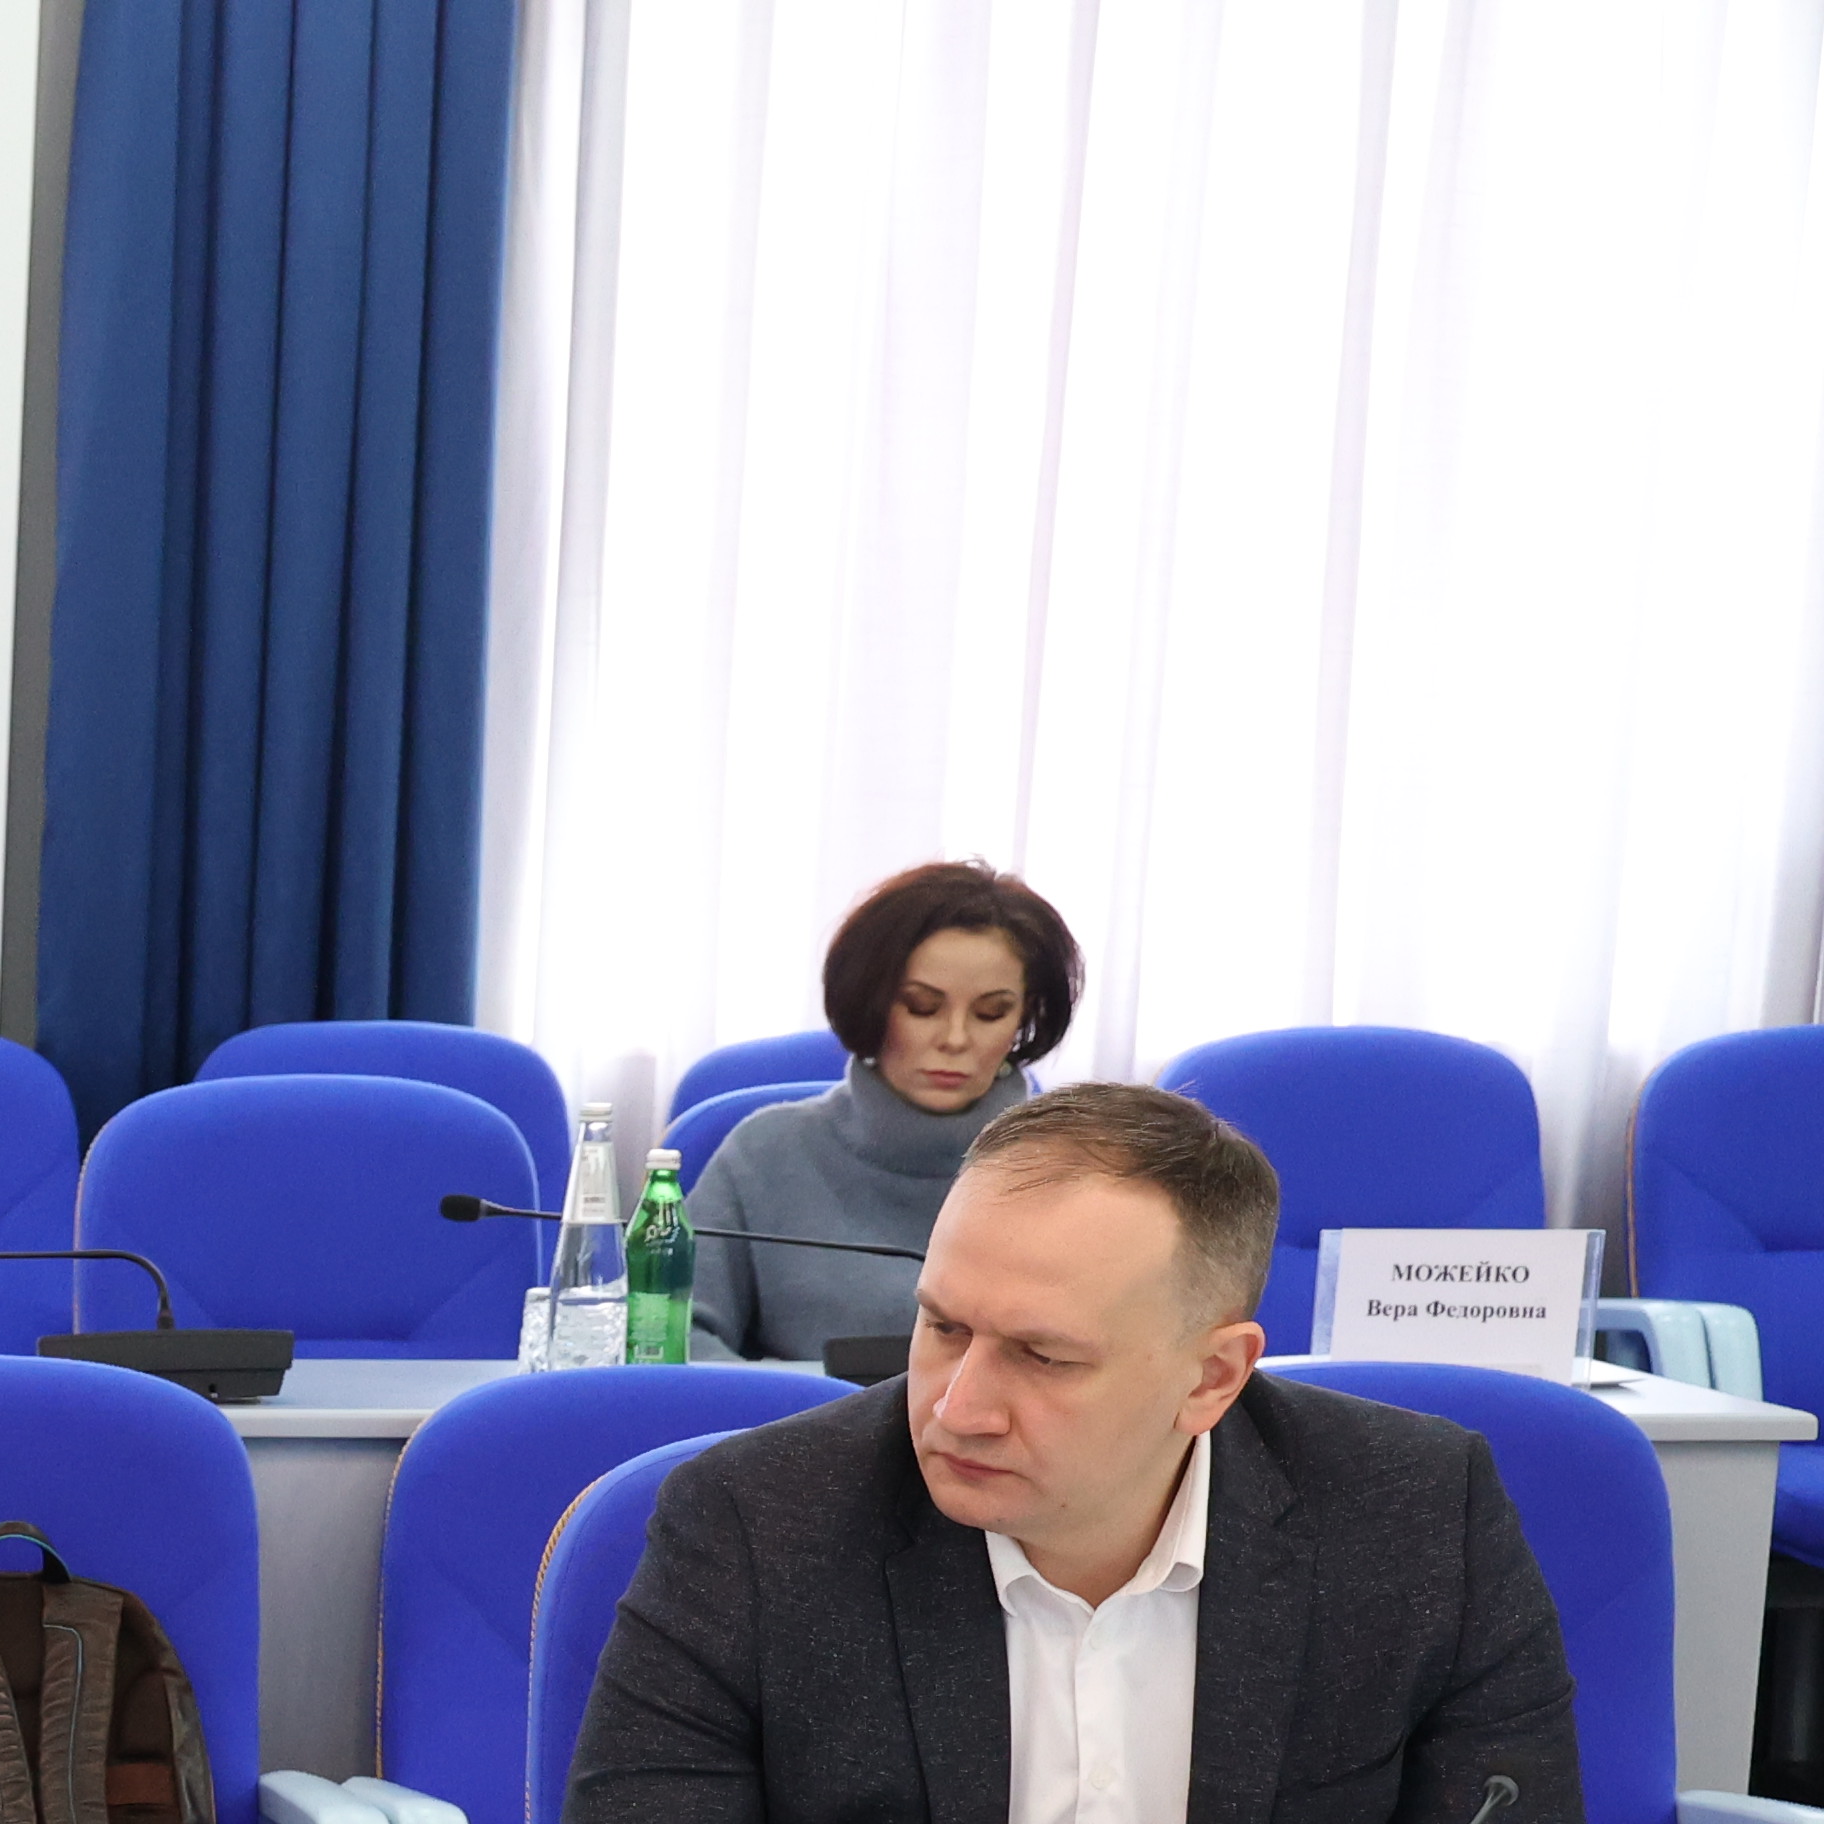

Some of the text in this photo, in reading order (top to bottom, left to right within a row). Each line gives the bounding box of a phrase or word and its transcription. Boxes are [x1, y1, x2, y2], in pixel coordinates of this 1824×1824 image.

[1393, 1261, 1529, 1283] МОЖЕЙКО
[1367, 1300, 1546, 1323] Вера Федоровна
